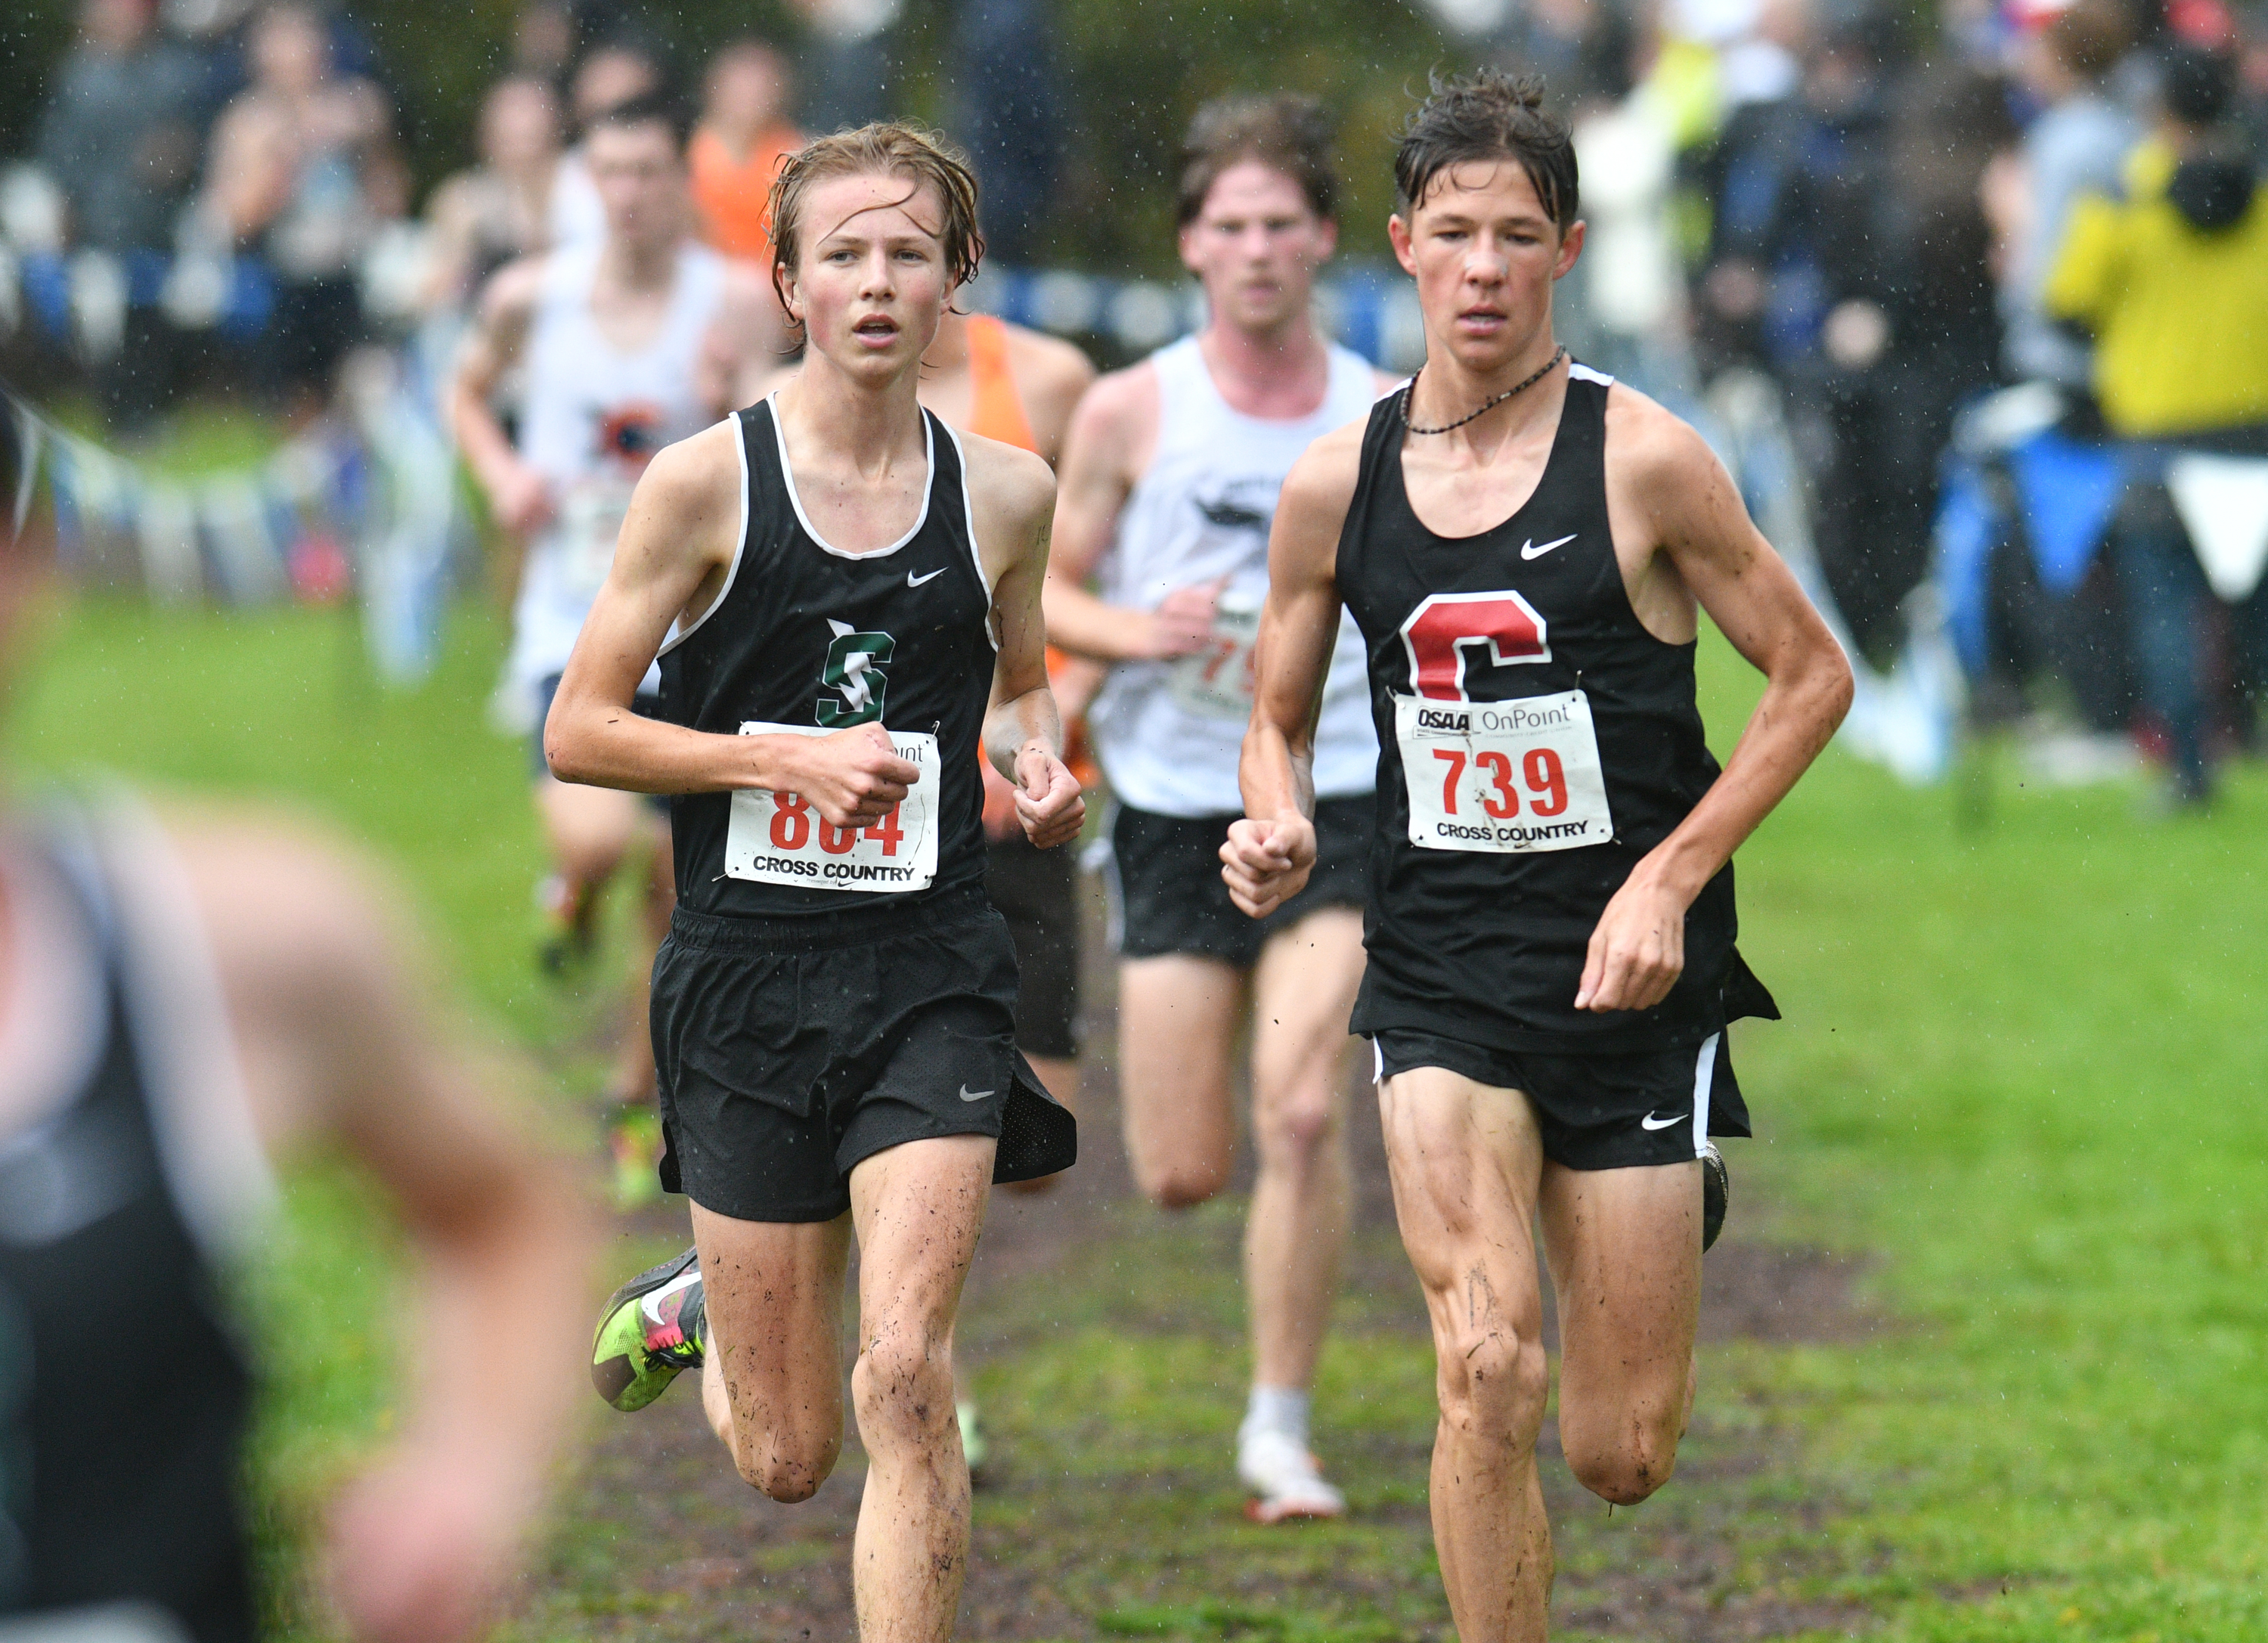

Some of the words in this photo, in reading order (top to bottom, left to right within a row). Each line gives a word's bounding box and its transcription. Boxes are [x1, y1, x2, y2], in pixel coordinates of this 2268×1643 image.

[1418, 708, 1470, 731] OSAA
[1483, 704, 1570, 730] OnPoint
[1433, 748, 1568, 819] 739
[1437, 822, 1492, 840] CROSS
[1498, 820, 1588, 841] COUNTRY
[753, 855, 818, 877] CROSS
[823, 863, 915, 881] COUNTRY
